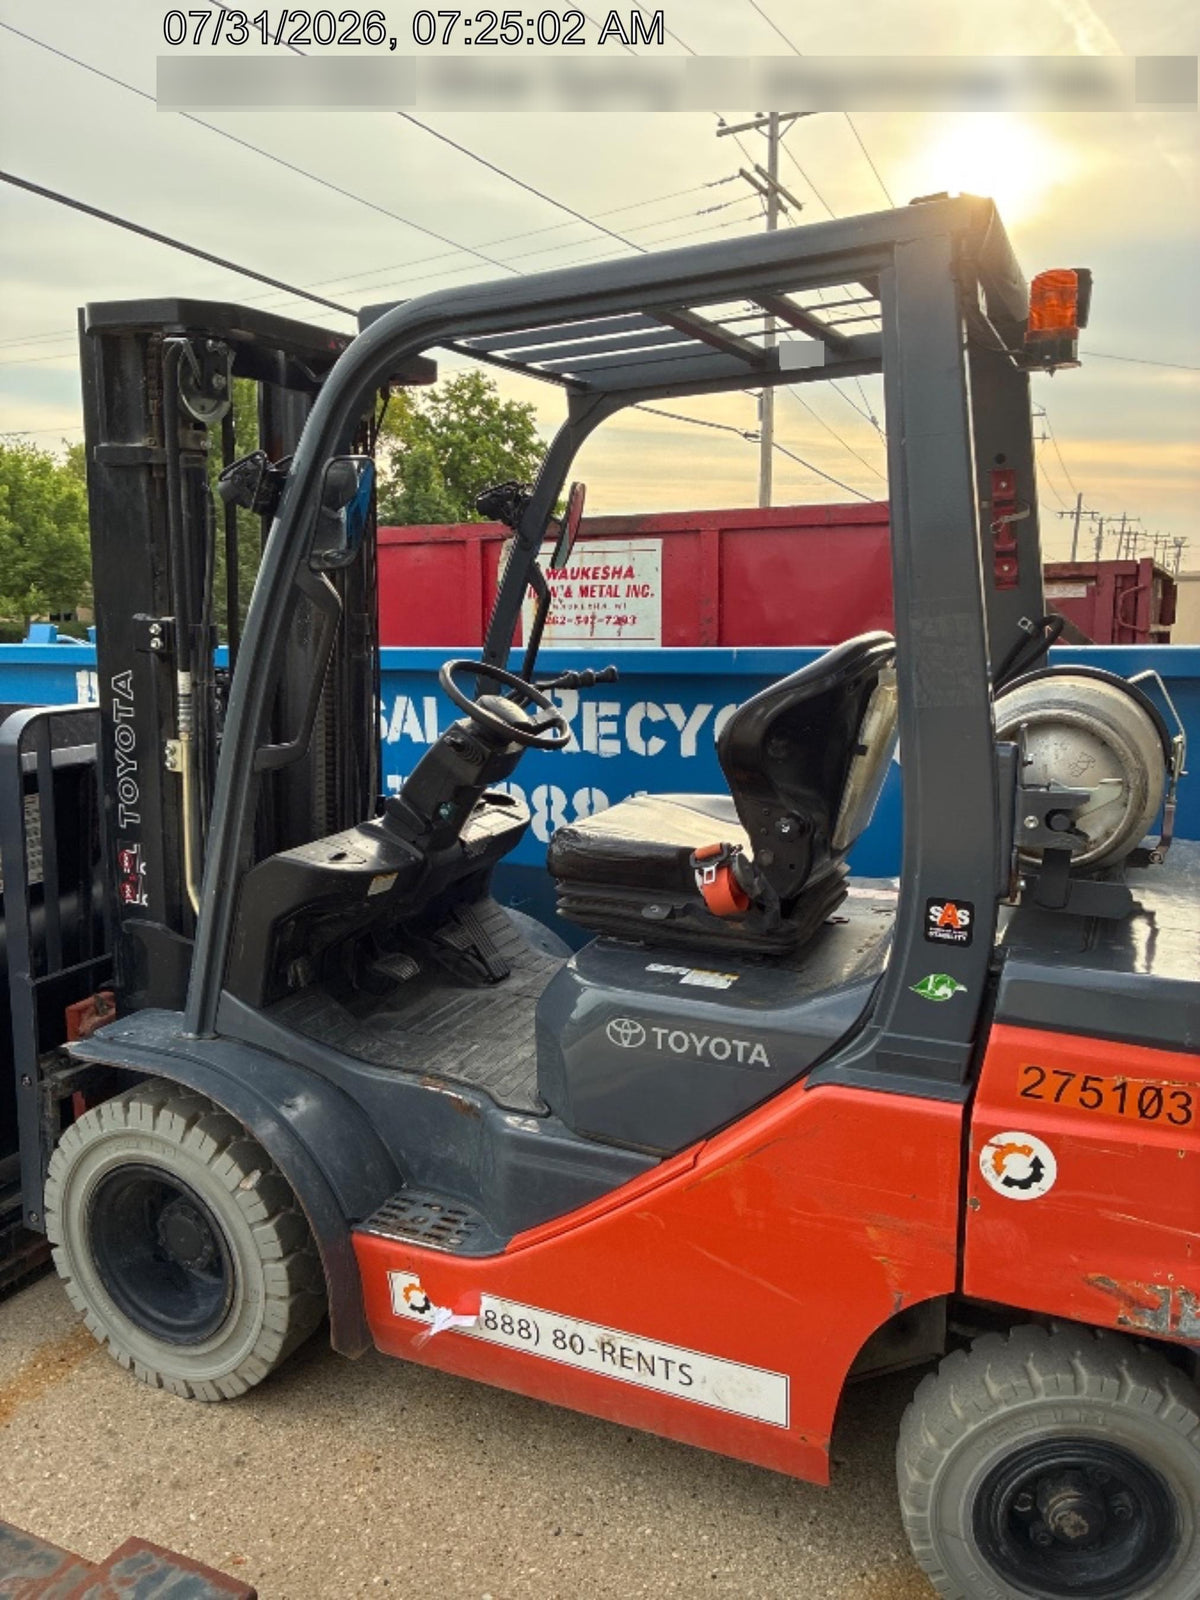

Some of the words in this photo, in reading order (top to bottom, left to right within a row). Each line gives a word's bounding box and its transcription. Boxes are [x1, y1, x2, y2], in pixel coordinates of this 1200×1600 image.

[546, 565, 635, 581] WAUKESHA
[563, 585, 573, 598] &
[578, 584, 620, 599] METAL
[626, 583, 655, 598] INC.
[111, 669, 141, 829] TOYOTA
[928, 902, 970, 929] SAS
[651, 1026, 771, 1068] TOYOTA
[1020, 1065, 1193, 1126] 275103
[552, 1328, 695, 1387] 80-RENTS
